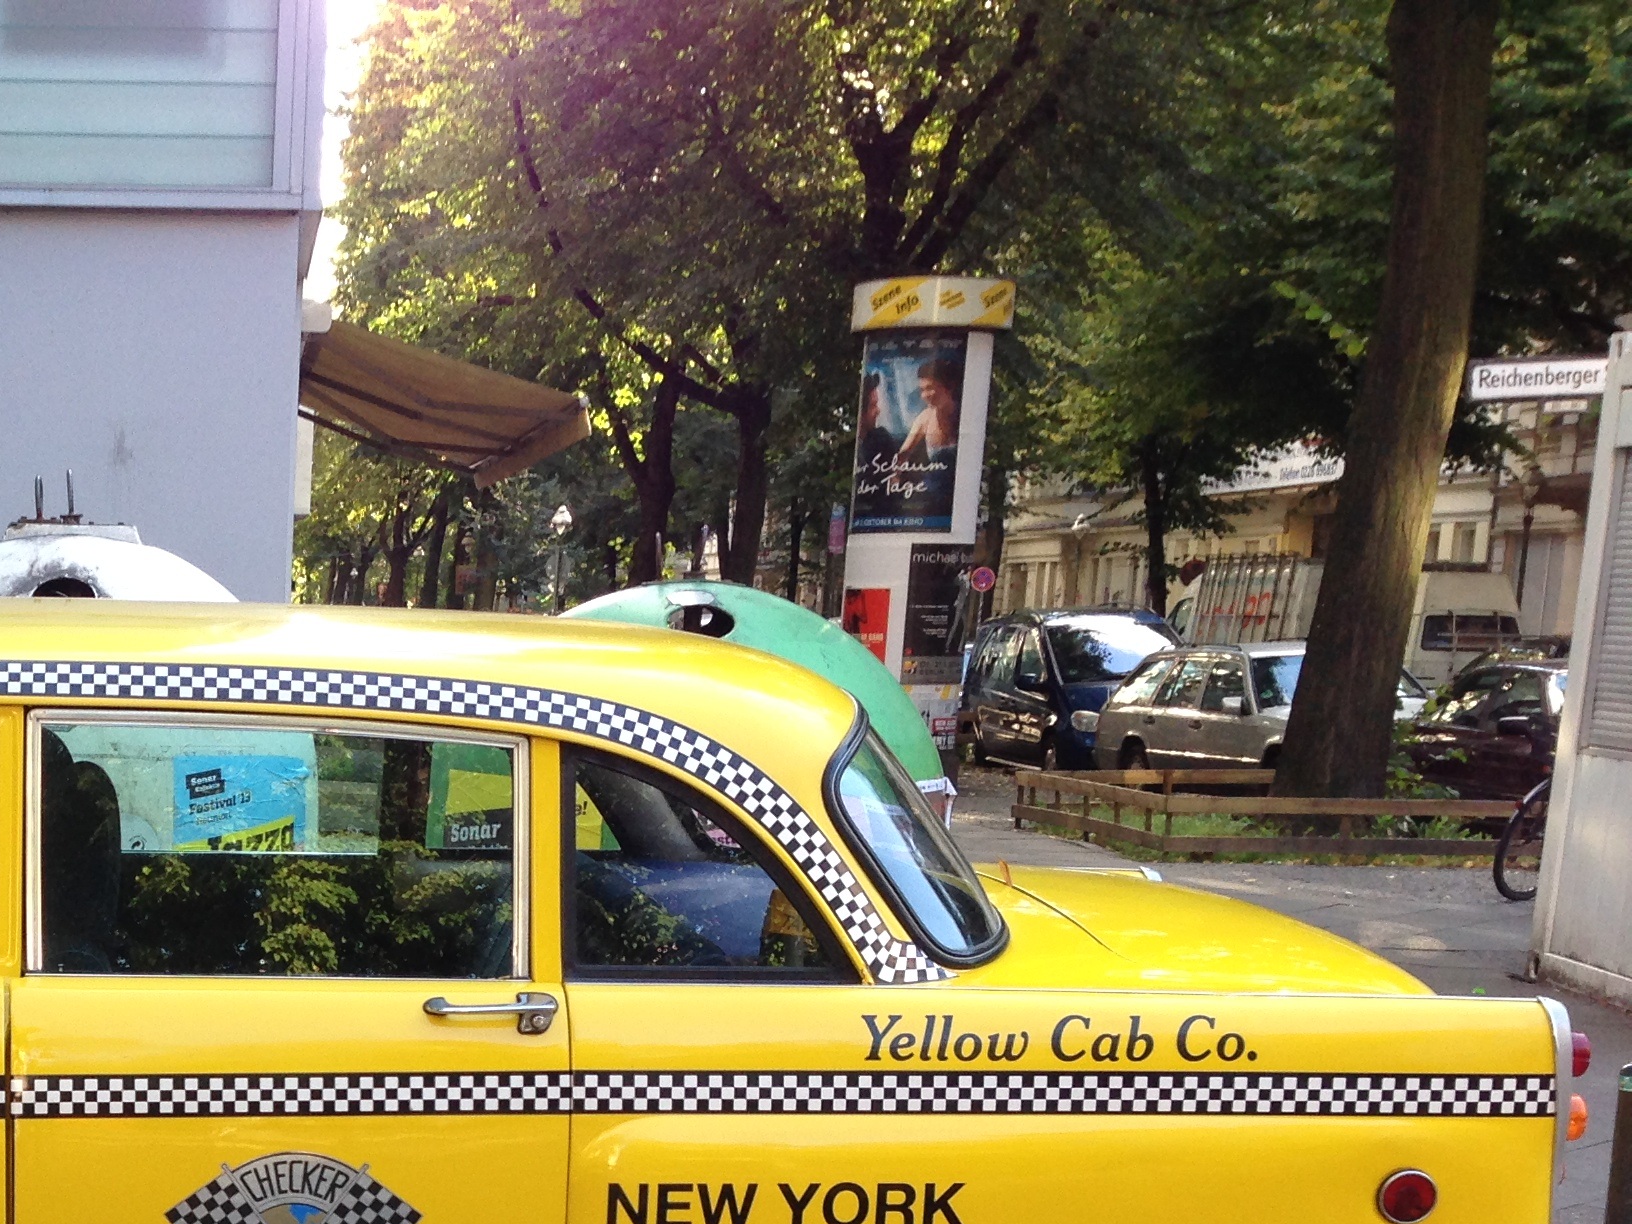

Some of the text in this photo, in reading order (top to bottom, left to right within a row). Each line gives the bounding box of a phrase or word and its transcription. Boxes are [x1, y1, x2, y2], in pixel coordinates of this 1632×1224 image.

[871, 284, 902, 311] Szene
[895, 294, 920, 315] Info
[1478, 365, 1601, 389] Reichenberger
[871, 452, 948, 475] Schaum
[857, 473, 928, 499] der Tage
[450, 822, 502, 843] Sonar
[861, 1014, 1258, 1063] Yellow Cab Co.
[239, 1160, 350, 1204] CHECKER
